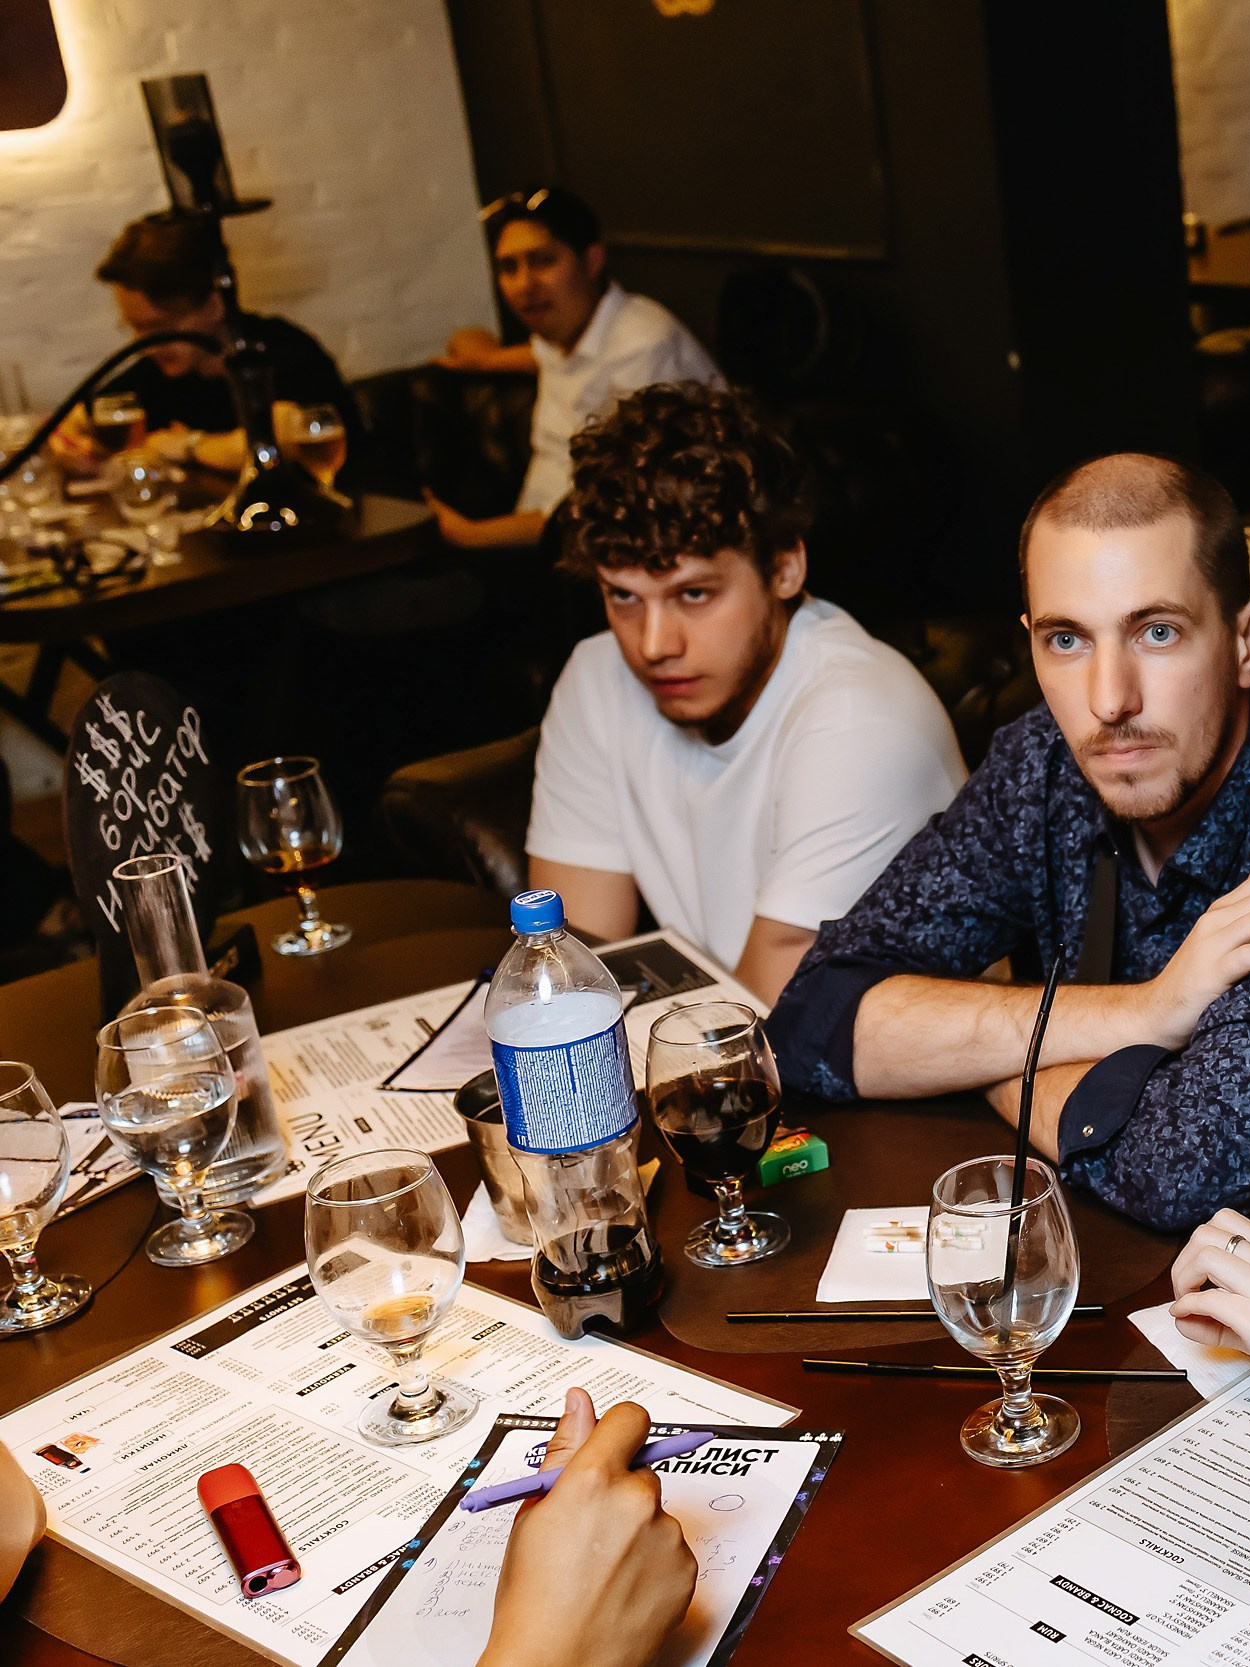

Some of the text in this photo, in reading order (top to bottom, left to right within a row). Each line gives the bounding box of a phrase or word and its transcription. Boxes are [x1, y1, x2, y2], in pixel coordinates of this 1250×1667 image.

[782, 1159, 809, 1175] neo
[301, 1366, 350, 1393] VERMOUTH
[504, 1380, 525, 1393] BEER
[495, 1418, 557, 1429] 0219374
[120, 1433, 166, 1460] НАПИТКИ
[700, 1447, 779, 1464] ЛИСТ
[139, 1443, 188, 1471] ЛИМОНАД
[652, 1460, 752, 1477] АПИСИ
[298, 1520, 349, 1551] COCKTAILS
[1138, 1538, 1185, 1564] COCKTAILS
[339, 1565, 378, 1591] BRANDY
[1221, 1568, 1244, 1581] ISLAND
[1052, 1578, 1093, 1599] BRANDY
[1096, 1600, 1133, 1622] COGNAC
[1175, 1601, 1214, 1623] KAZAKHSTAN
[1183, 1596, 1221, 1618] KAZAKHSTAN
[1036, 1624, 1059, 1639] RUM
[983, 1651, 1008, 1667] SPIRITS
[1135, 1646, 1162, 1663] BACARDI
[1147, 1643, 1170, 1657] SAILOR
